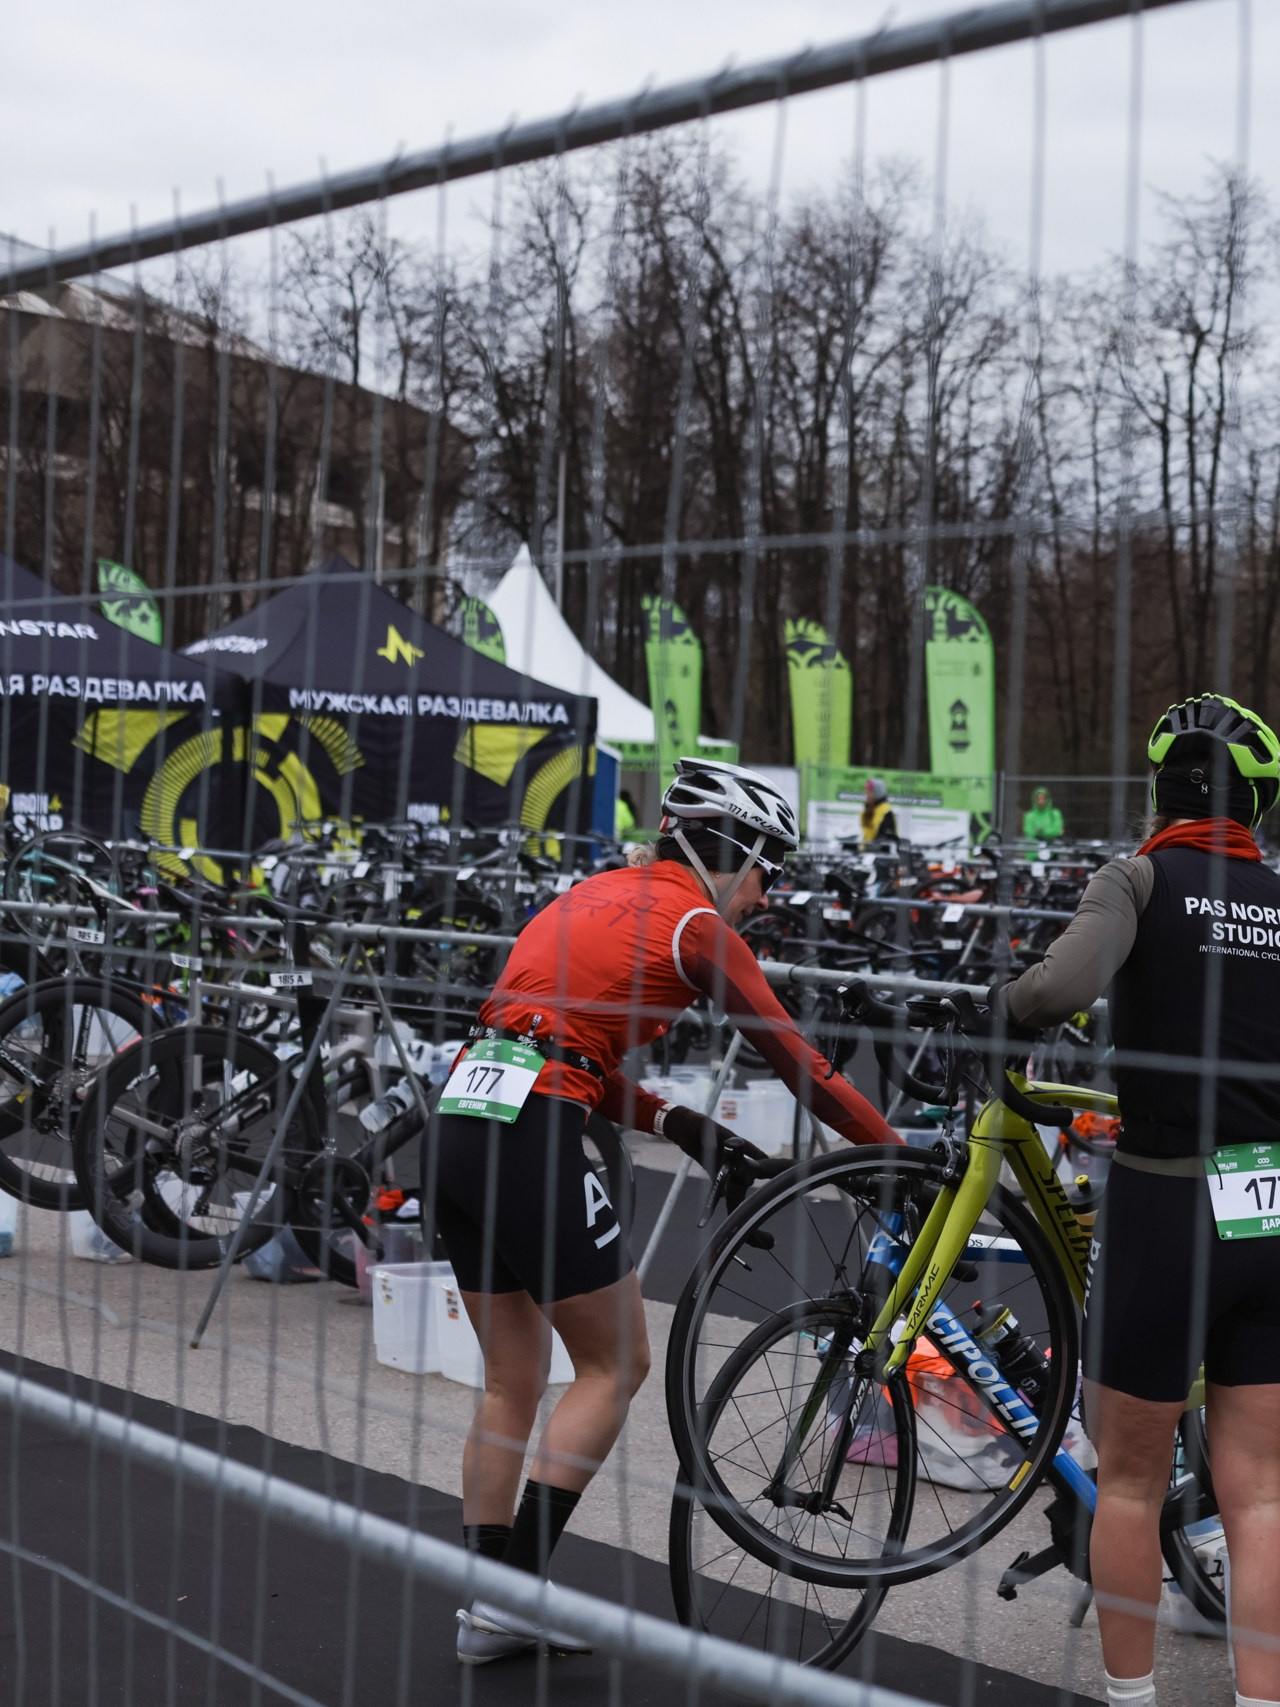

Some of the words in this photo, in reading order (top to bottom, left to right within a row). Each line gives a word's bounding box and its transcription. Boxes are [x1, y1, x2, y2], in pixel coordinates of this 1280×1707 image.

[31, 674, 206, 703] РАЗДЕВАЛКА
[289, 687, 413, 716] МУЖСКАЯ
[417, 695, 569, 724] РАЗДЕВАЛКА
[727, 803, 742, 816] 177
[741, 809, 749, 820] A
[751, 815, 787, 837] RUDY
[1184, 896, 1227, 918] PAS
[1198, 944, 1260, 960] INTERNATIONAL
[297, 974, 305, 986] A
[467, 1066, 506, 1095] 177
[457, 1099, 488, 1112] ЕВГЕНИЯ
[905, 1262, 940, 1333] TARMAC
